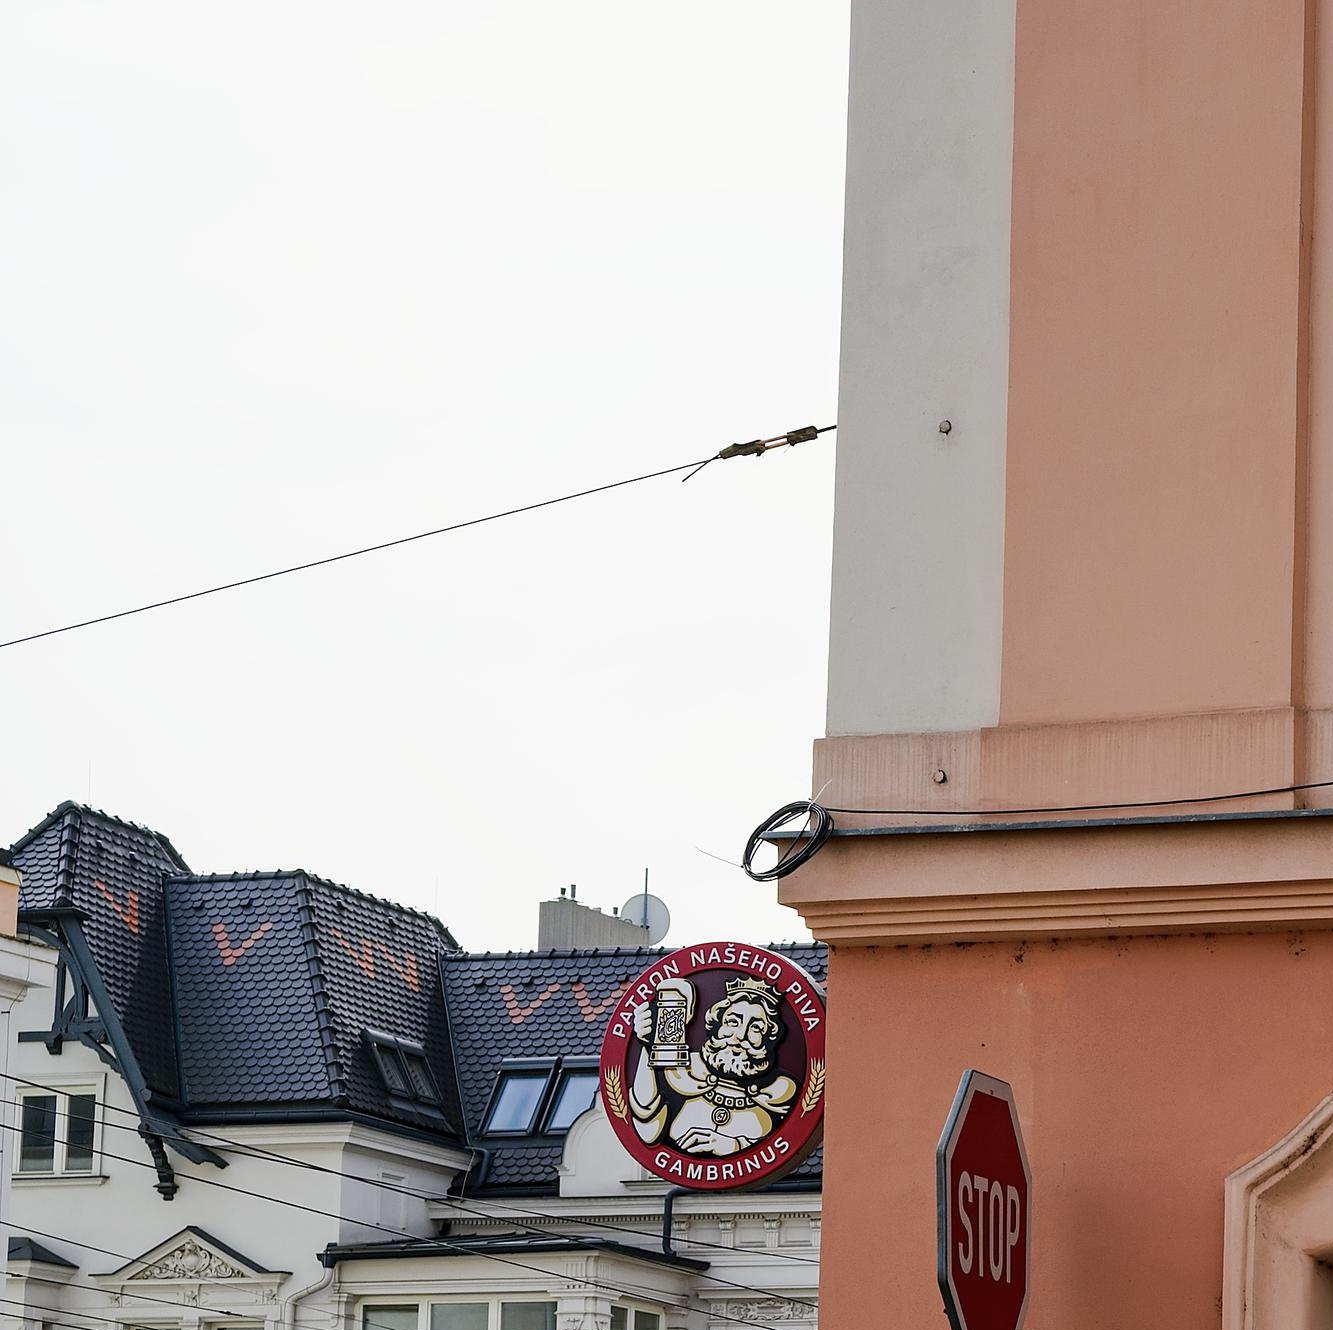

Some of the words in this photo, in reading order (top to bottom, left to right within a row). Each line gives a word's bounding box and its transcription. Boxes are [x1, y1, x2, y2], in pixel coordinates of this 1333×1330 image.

[612, 959, 680, 1038] PATRON
[690, 942, 783, 981] NAŠEHO
[785, 981, 821, 1032] PIVA
[654, 1136, 791, 1182] GAMBRINUS
[958, 1170, 1020, 1284] STOP
